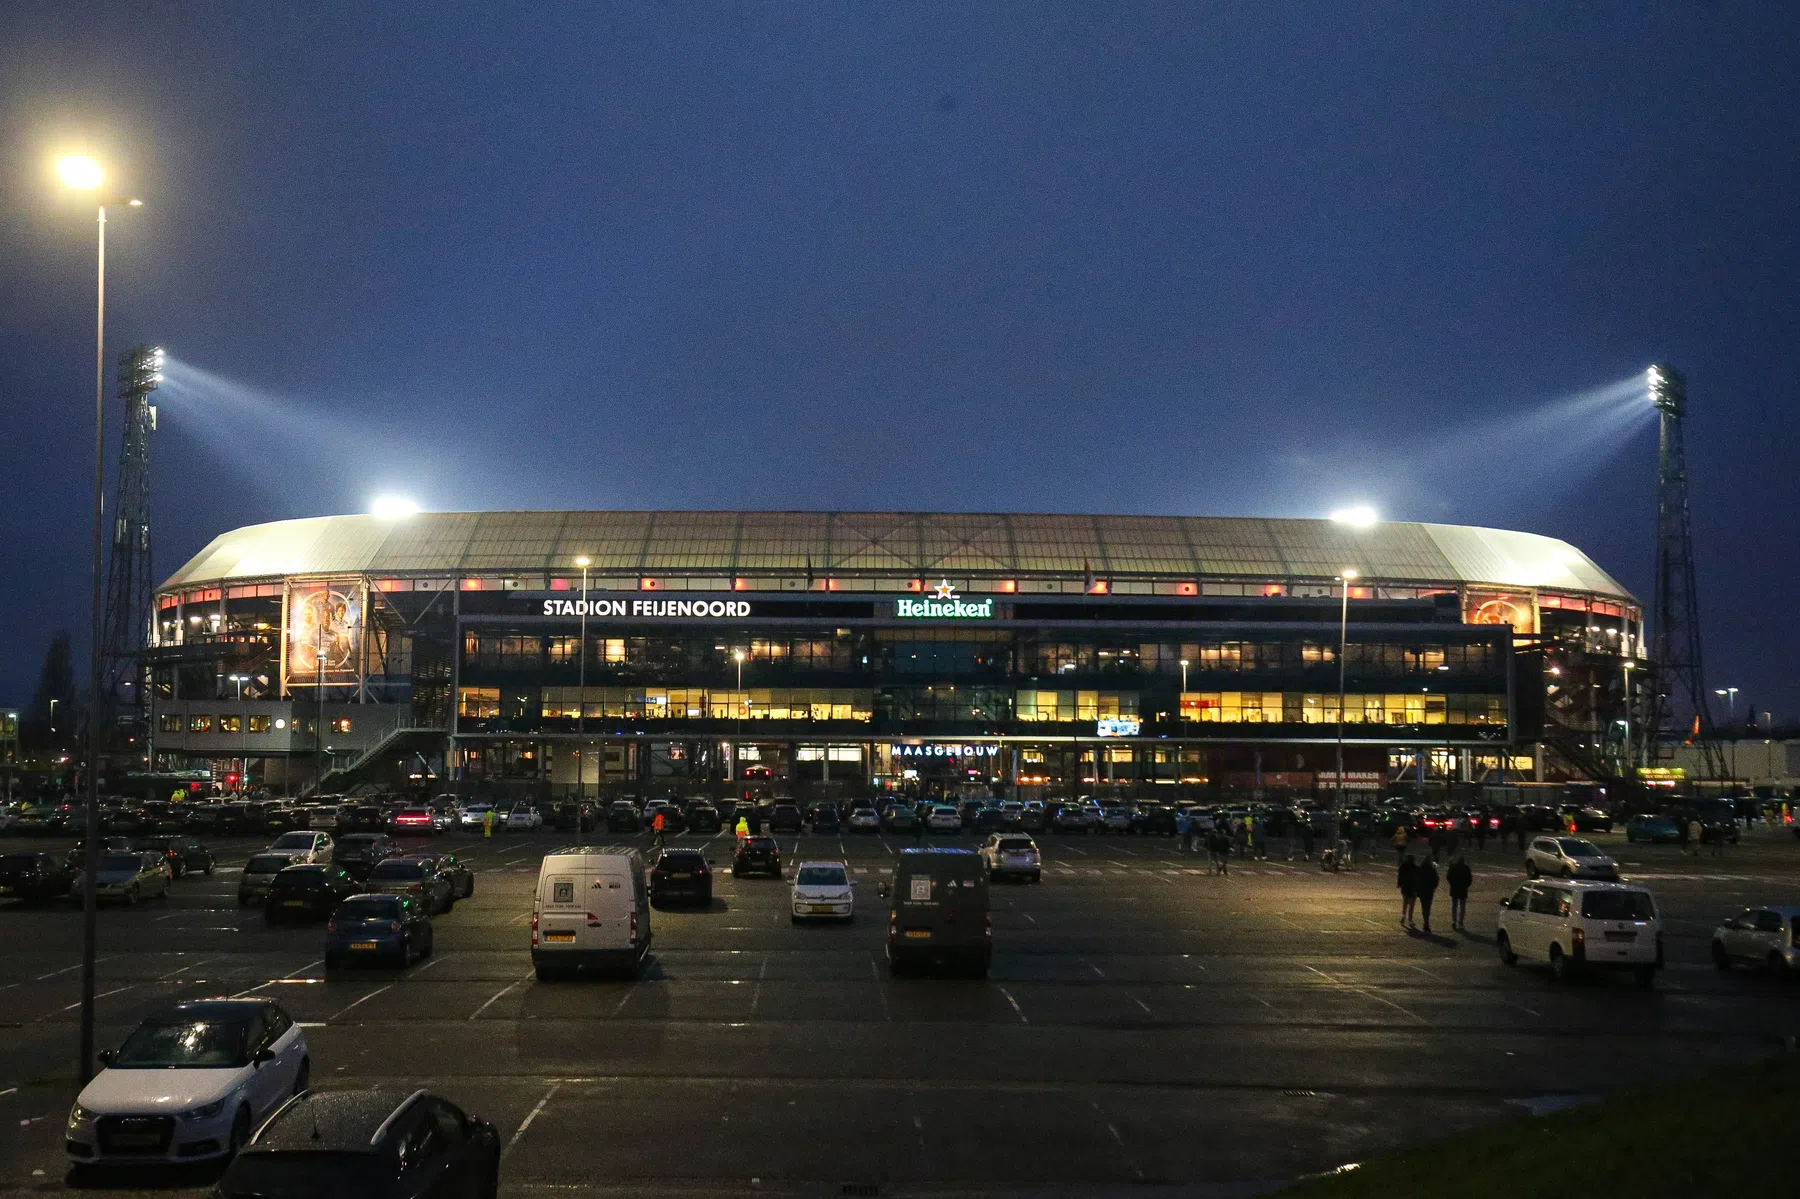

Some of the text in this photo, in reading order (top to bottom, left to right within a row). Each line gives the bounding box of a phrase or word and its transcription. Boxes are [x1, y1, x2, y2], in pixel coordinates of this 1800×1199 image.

[543, 599, 751, 617] STADION FEIJENOORD
[897, 599, 992, 617] Heineken
[891, 745, 999, 756] MAASGEBOUW
